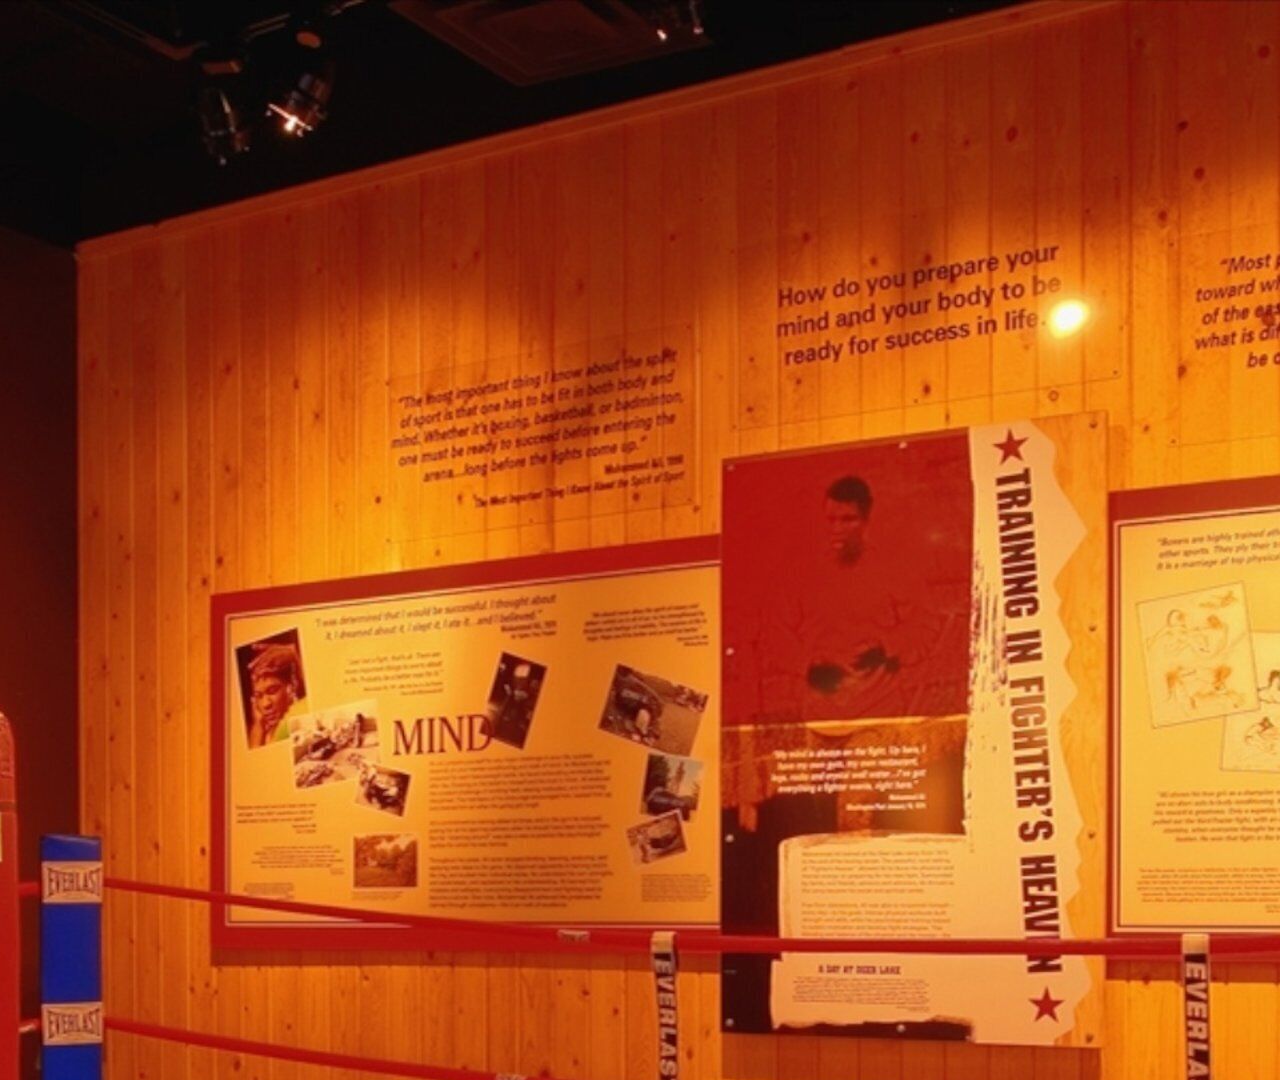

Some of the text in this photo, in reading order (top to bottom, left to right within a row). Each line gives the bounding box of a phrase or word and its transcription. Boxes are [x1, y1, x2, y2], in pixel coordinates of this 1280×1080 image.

[777, 245, 1060, 309] How do you prepare your
[1196, 278, 1256, 303] toward
[776, 274, 1060, 339] mind and your body to be
[1201, 306, 1220, 326] of
[1223, 305, 1250, 323] the
[785, 308, 1046, 366] ready for success in life
[1194, 331, 1237, 350] what
[1240, 326, 1255, 345] is
[1247, 351, 1268, 368] be
[393, 714, 492, 757] MIND
[995, 467, 1063, 973] TRAINING IN FIGHTER'S HEAVN
[48, 867, 102, 897] EVERLAST
[47, 1008, 102, 1040] EVERLAST
